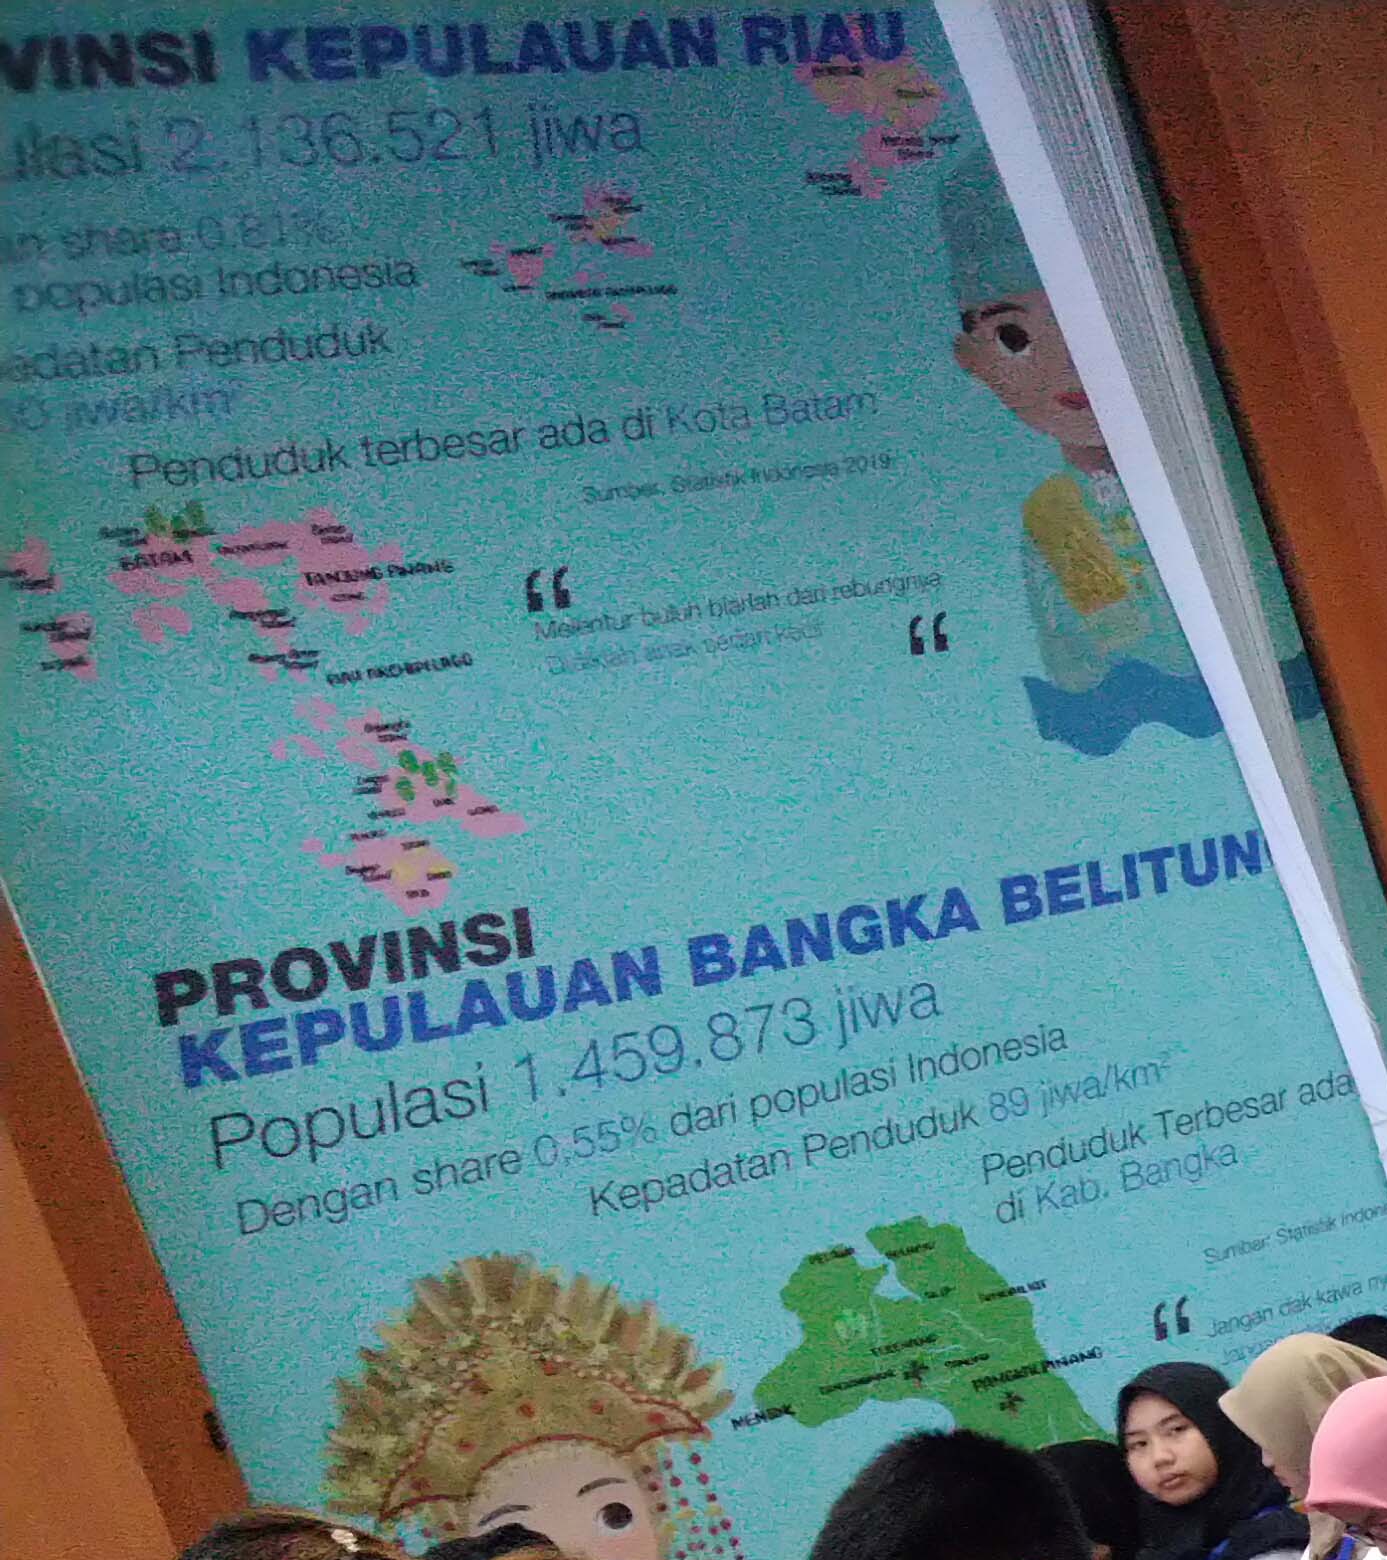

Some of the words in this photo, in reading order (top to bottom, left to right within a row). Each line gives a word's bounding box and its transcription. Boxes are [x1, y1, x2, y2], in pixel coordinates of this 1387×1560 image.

[246, 16, 718, 82] KEPULAUAN
[743, 11, 906, 66] RIAU
[163, 106, 499, 174] 2.136.521
[531, 103, 644, 168] jiwa
[217, 259, 421, 299] Indonesia
[172, 322, 393, 370] Penduduk
[131, 438, 352, 488] Penduduk
[361, 423, 523, 468] terbesar
[538, 413, 610, 449] ada
[622, 406, 655, 441] di
[666, 399, 752, 434] Kota
[763, 391, 879, 425] Batam
[153, 906, 537, 1027] PROVINSI
[178, 945, 663, 1089] KEPULAUAN
[687, 886, 981, 988] BANGKA
[1000, 828, 1273, 927] BELITUN
[209, 1062, 490, 1170] Populasi
[512, 996, 817, 1102] 1.459.873
[834, 977, 942, 1051] jiwa
[236, 1172, 399, 1236] Dengan
[412, 1144, 523, 1198] share
[531, 1111, 659, 1171] 0,55%
[669, 1096, 738, 1139] dari
[750, 1061, 898, 1129] populasi
[907, 1023, 1069, 1083] Indonesia
[587, 1144, 792, 1217] Kepadatan
[803, 1099, 982, 1169] Penduduk
[989, 1083, 1030, 1123] 89
[981, 1125, 1148, 1187] Penduduk
[1153, 1093, 1289, 1142] Terbesar
[1297, 1071, 1357, 1110] ada
[996, 1190, 1026, 1226] di
[1034, 1174, 1110, 1217] Kab.
[1120, 1142, 1239, 1193] Bangka
[1207, 1304, 1274, 1338] Jangan
